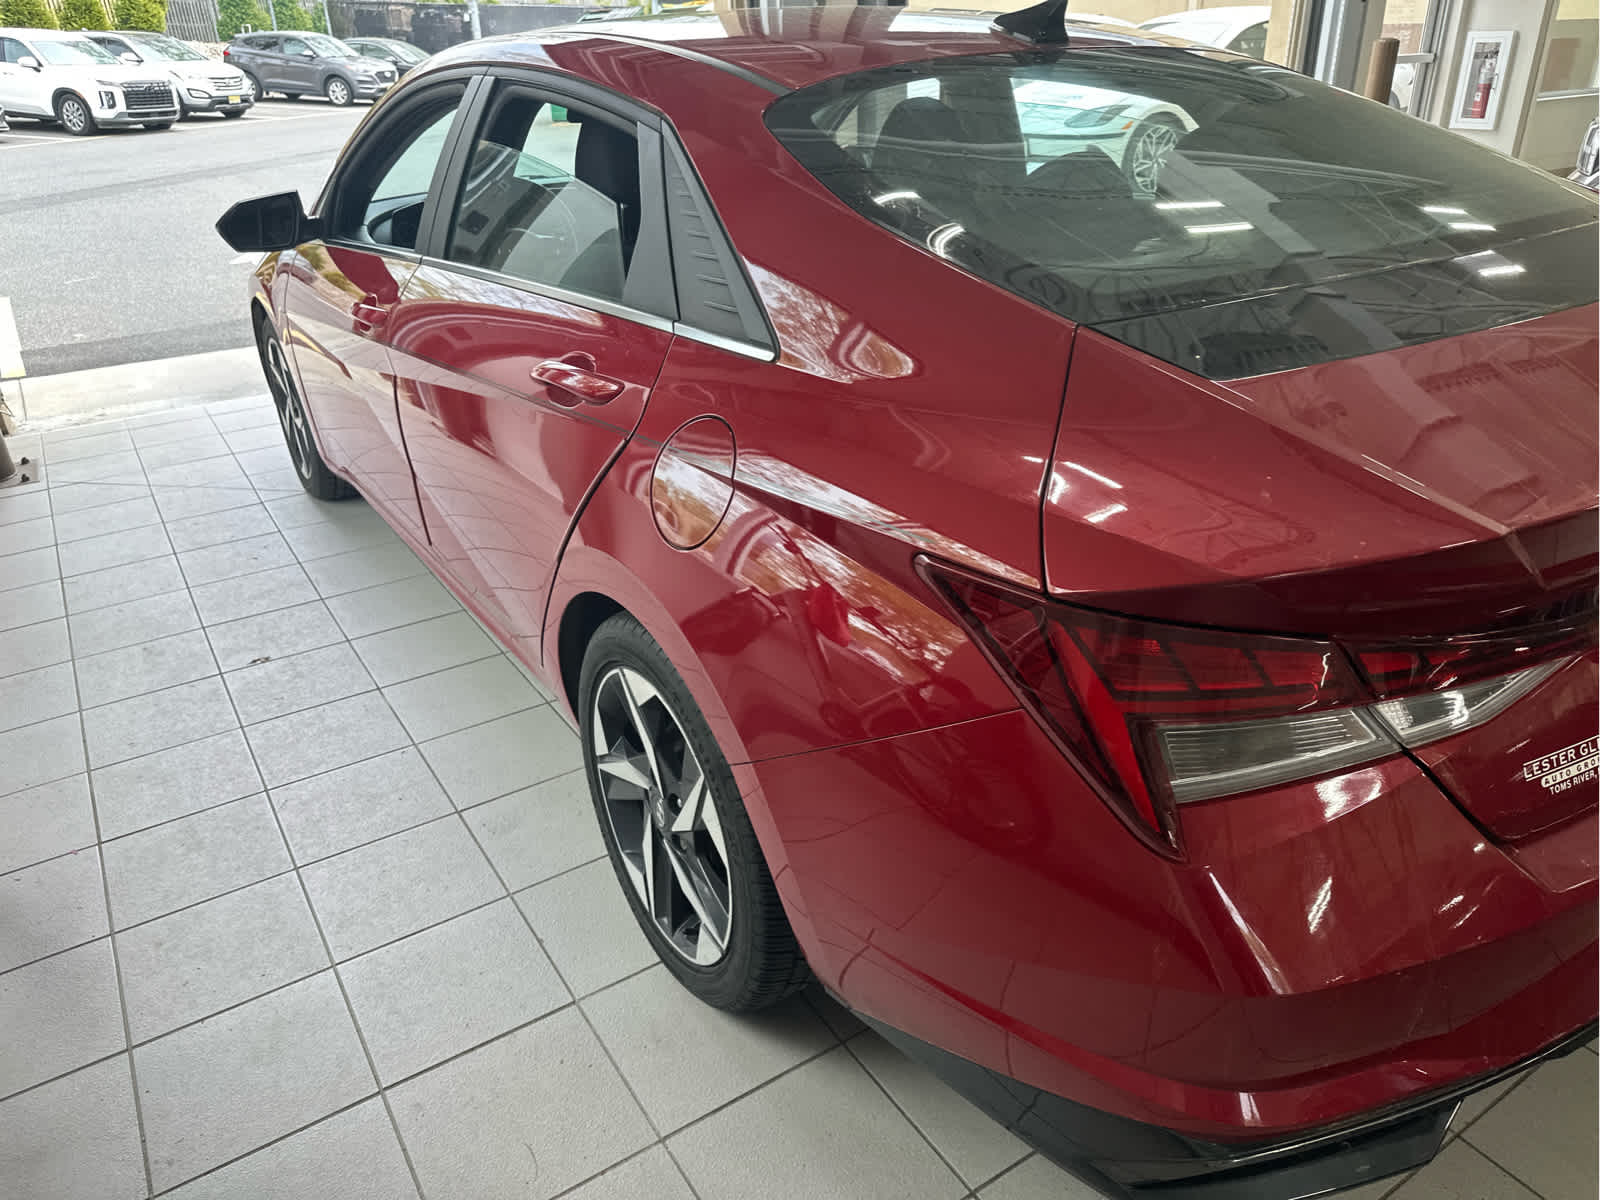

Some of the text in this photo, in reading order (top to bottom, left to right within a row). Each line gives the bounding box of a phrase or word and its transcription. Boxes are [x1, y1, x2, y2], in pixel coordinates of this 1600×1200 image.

[1523, 749, 1576, 778] LESTER
[1544, 769, 1571, 784] AUTO
[1550, 781, 1572, 795] TOMS
